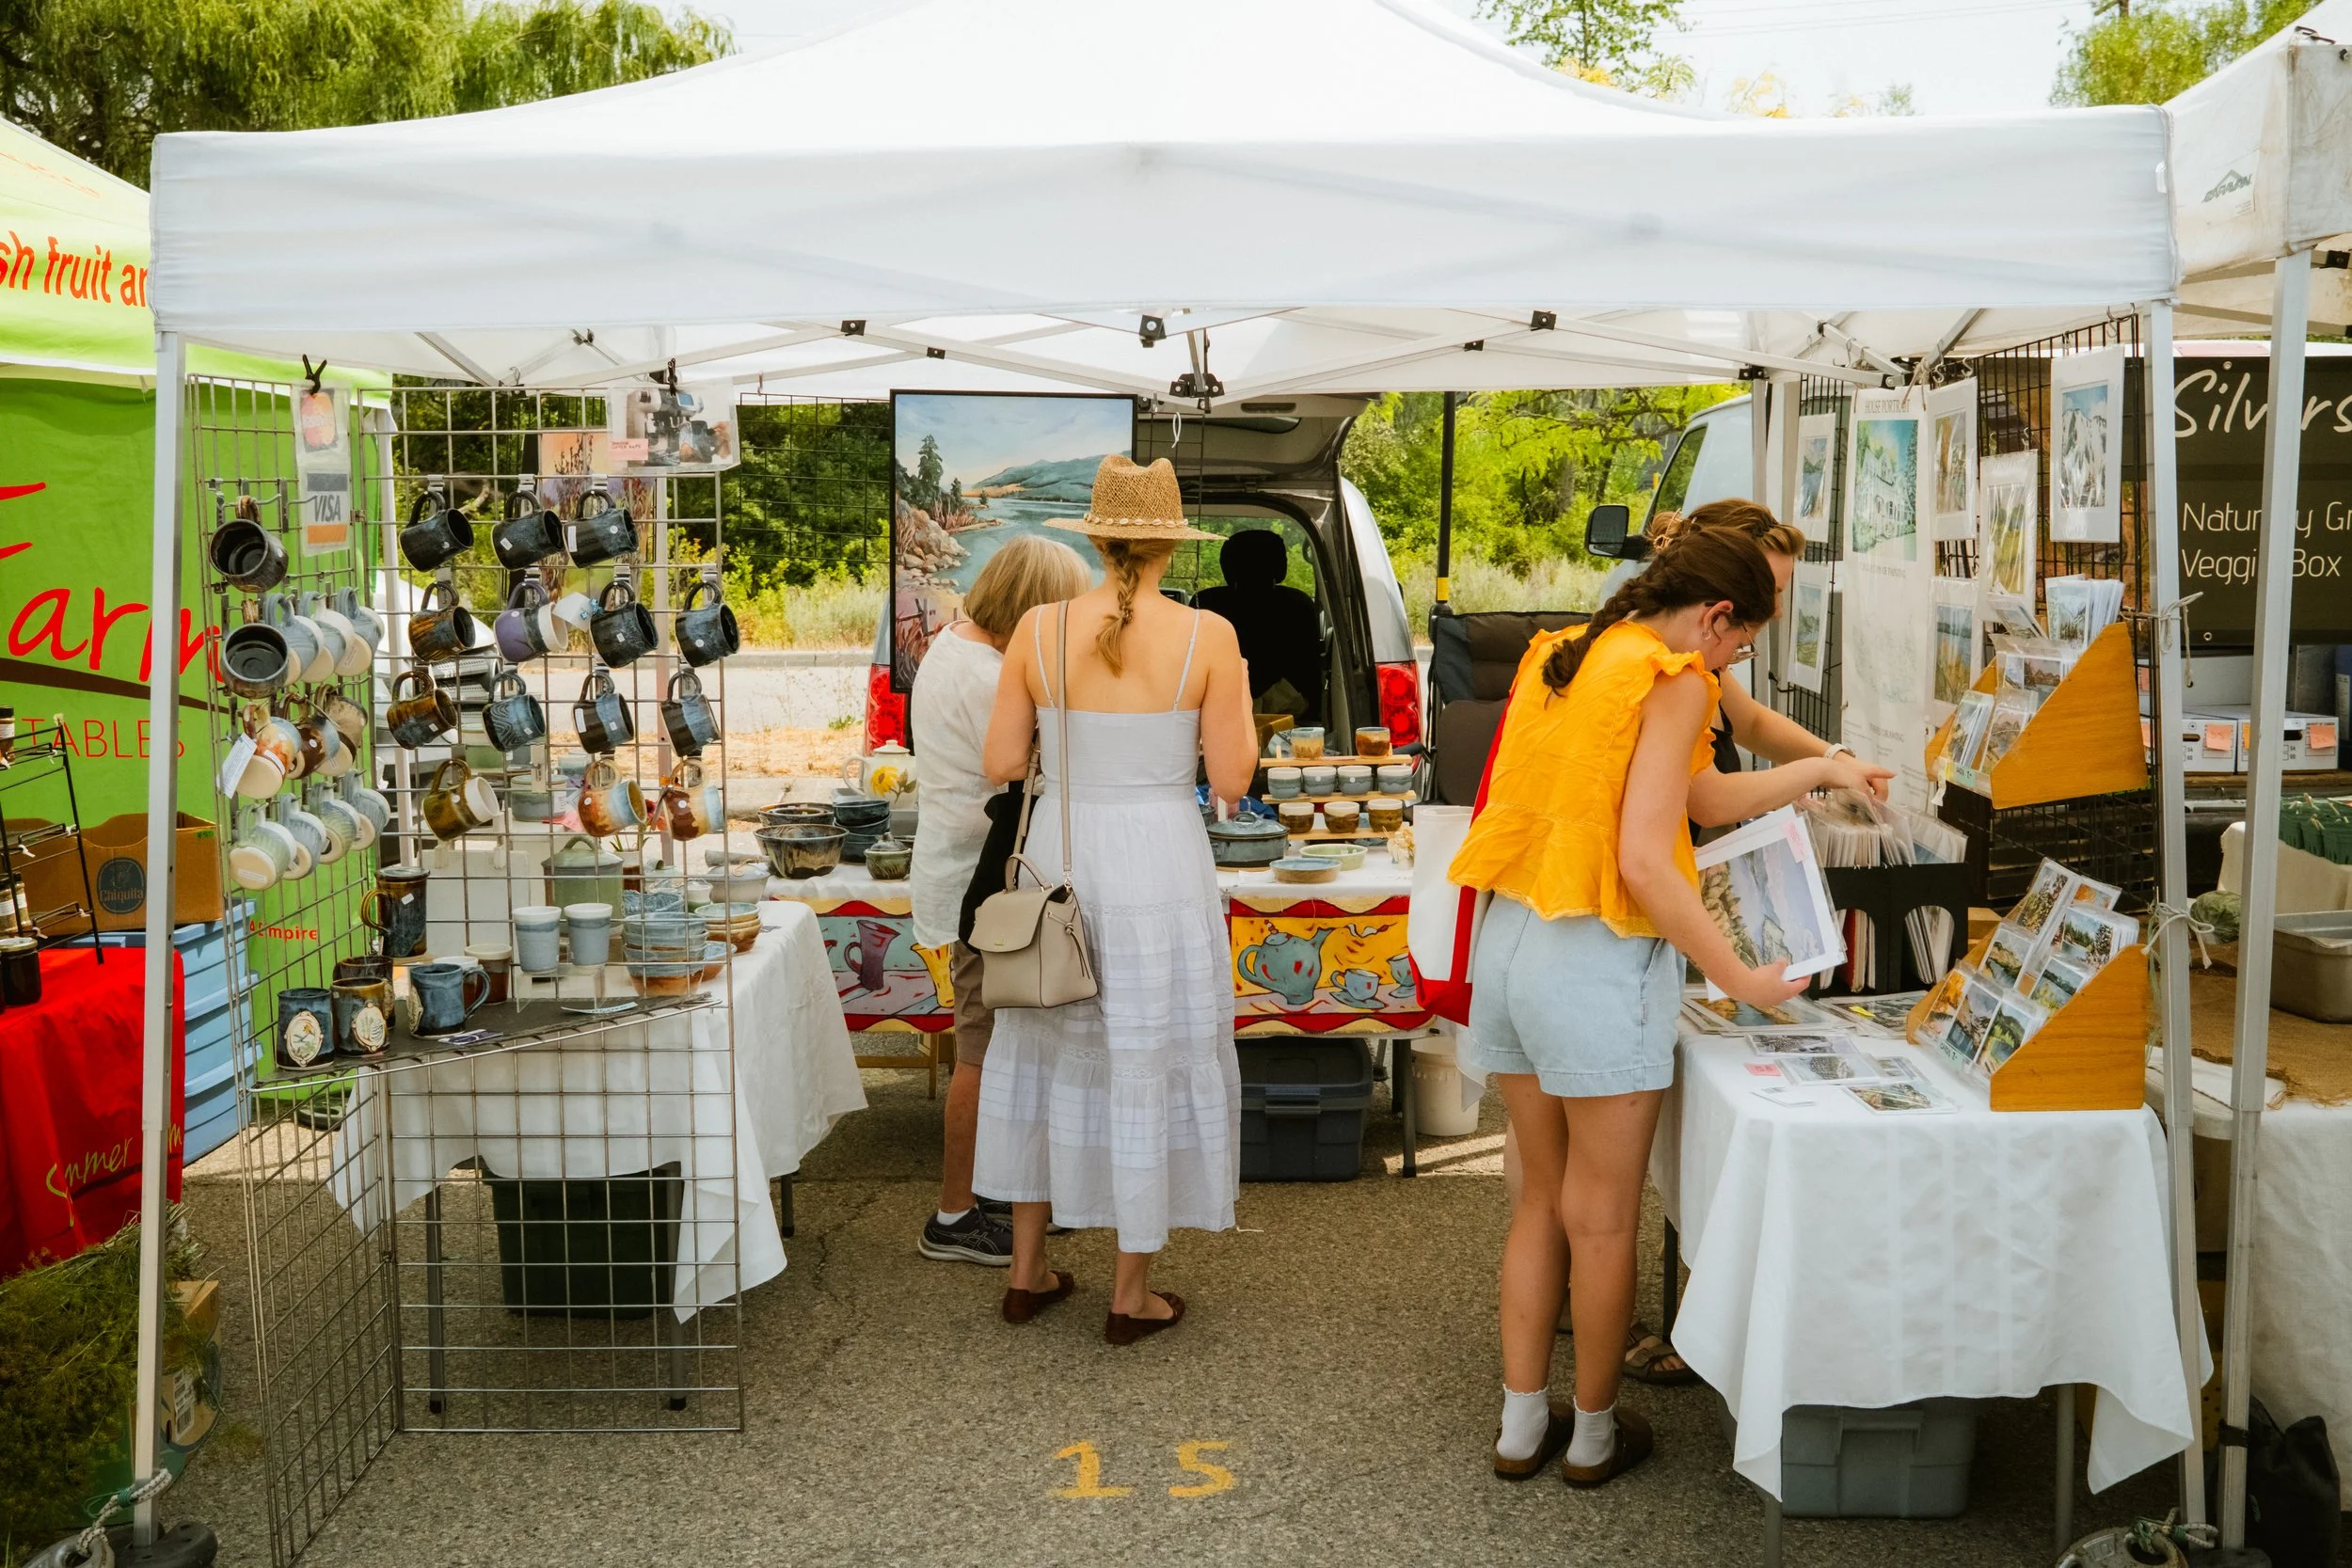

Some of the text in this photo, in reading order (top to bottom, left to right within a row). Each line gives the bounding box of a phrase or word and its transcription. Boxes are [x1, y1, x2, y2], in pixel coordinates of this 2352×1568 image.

[44, 236, 112, 304] fruit
[2174, 369, 2352, 437] Silvrs
[314, 495, 342, 522] VISA
[2182, 548, 2342, 585] Veggi Box
